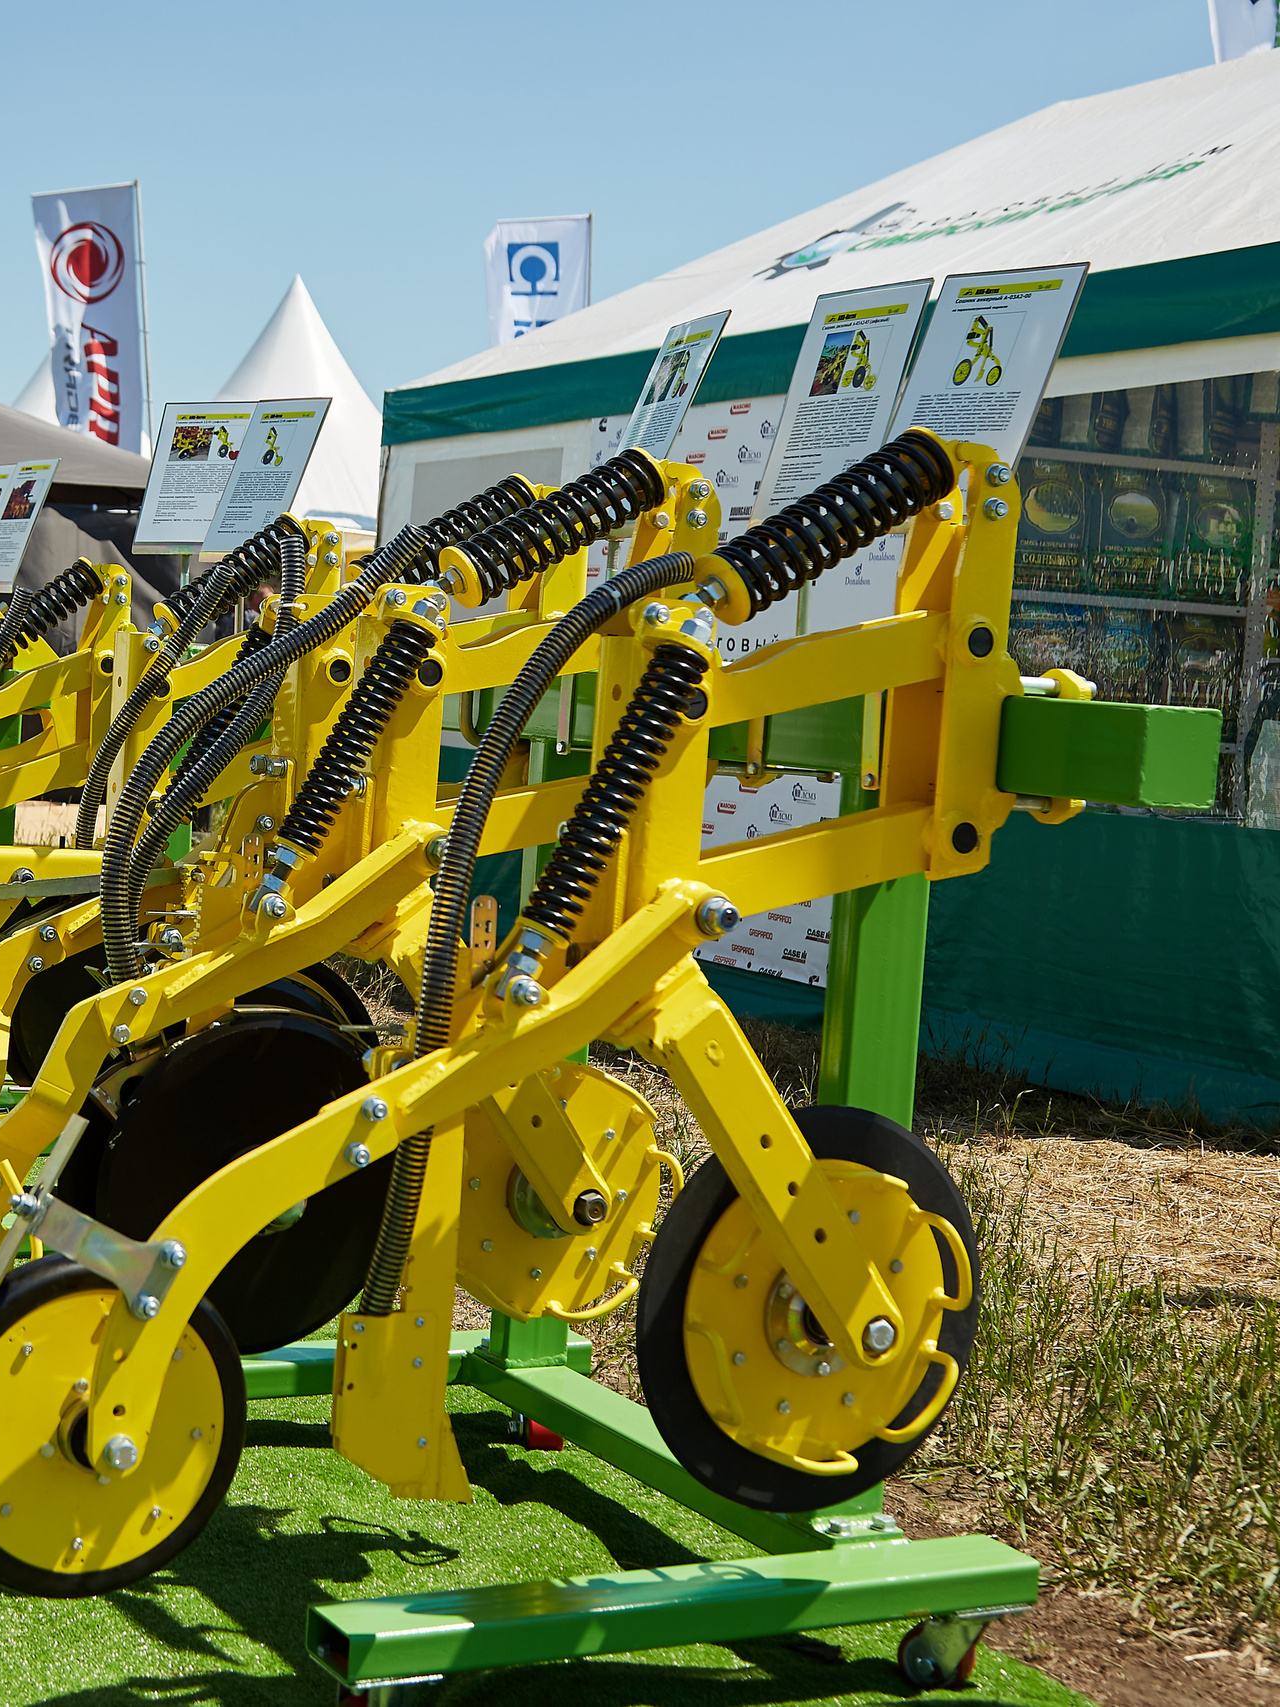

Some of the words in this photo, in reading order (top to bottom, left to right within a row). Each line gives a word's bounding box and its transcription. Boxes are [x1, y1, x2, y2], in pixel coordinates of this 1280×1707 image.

[749, 928, 773, 940] GASPARDO
[806, 928, 824, 938] CASE
[731, 944, 754, 955] GASPARDO
[783, 948, 801, 958] CASE
